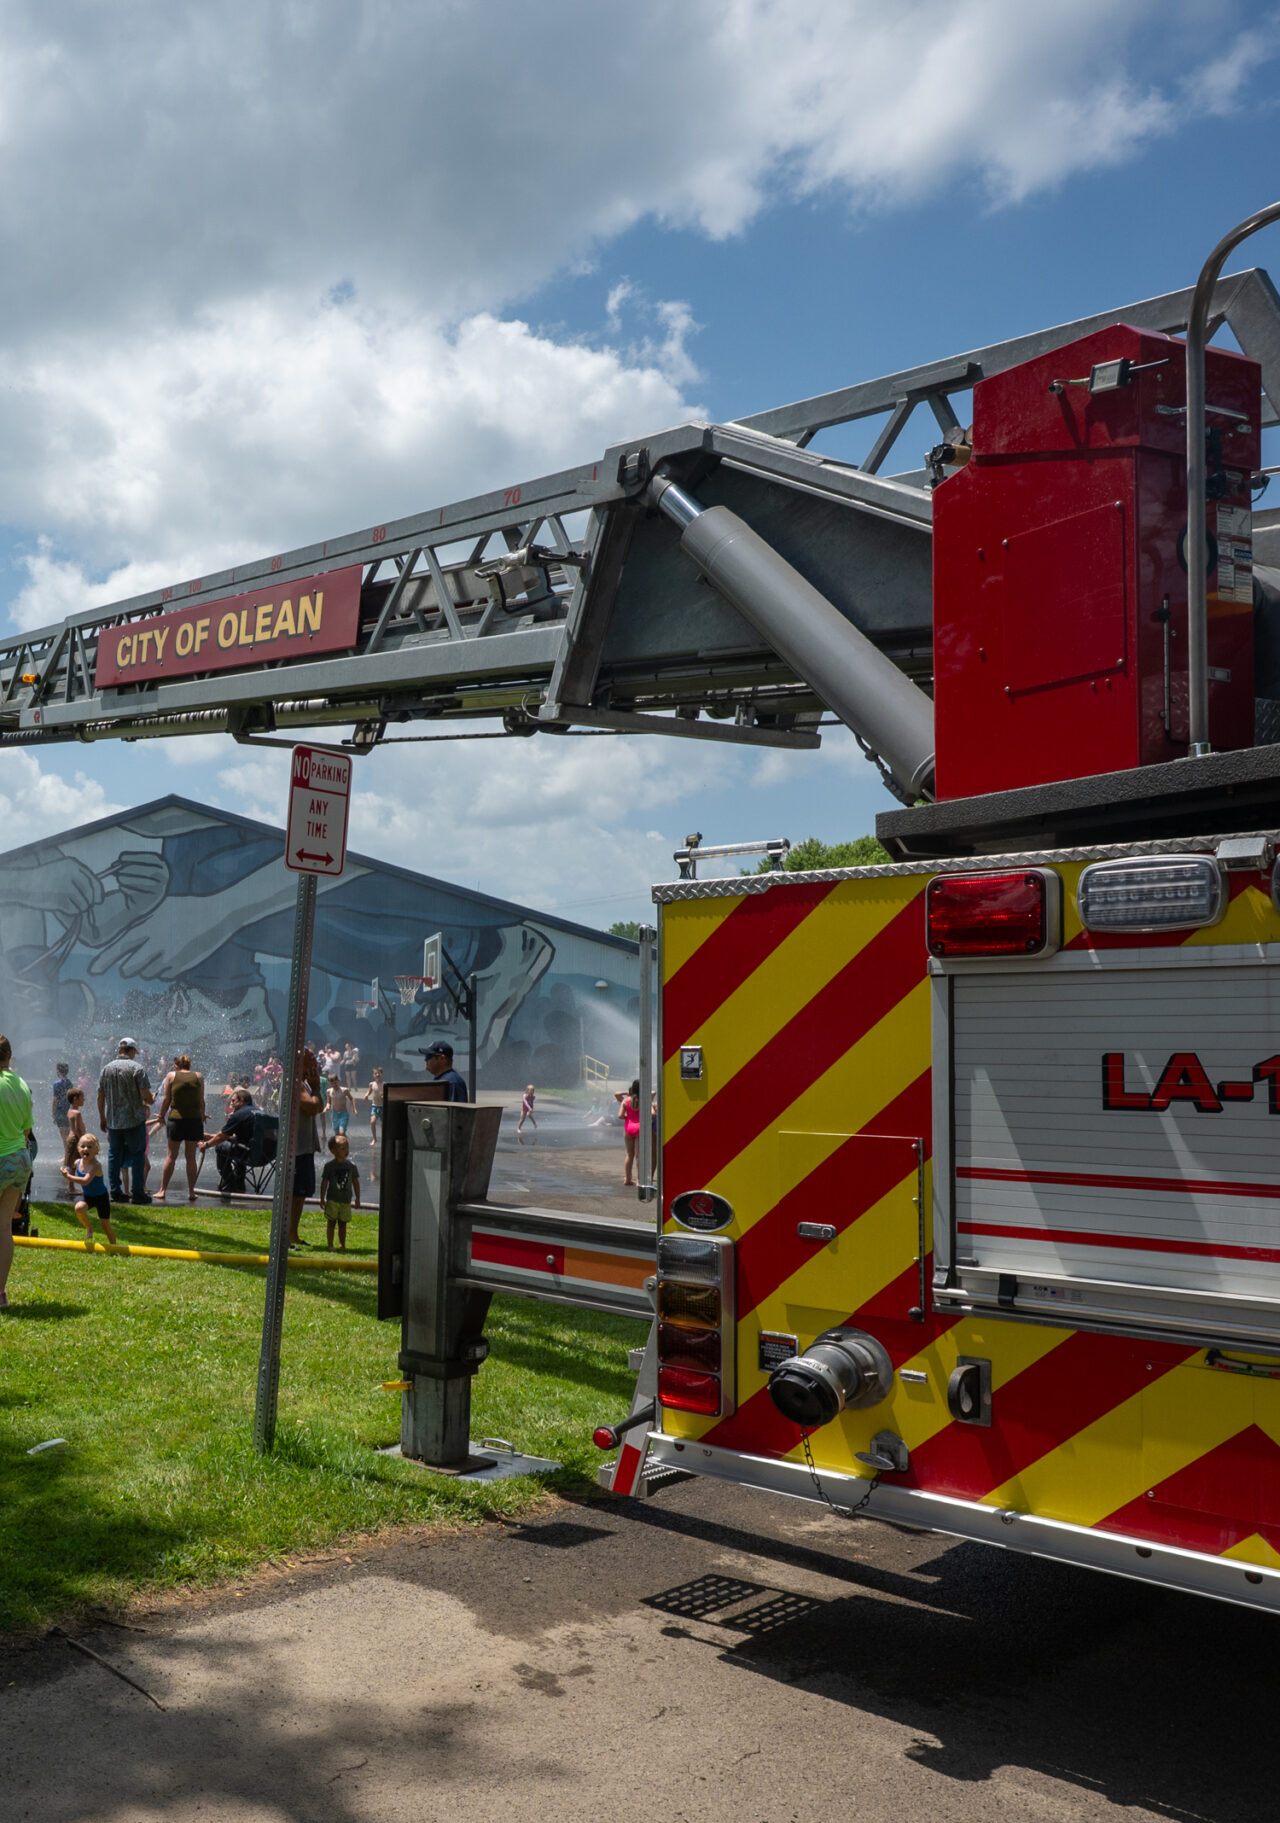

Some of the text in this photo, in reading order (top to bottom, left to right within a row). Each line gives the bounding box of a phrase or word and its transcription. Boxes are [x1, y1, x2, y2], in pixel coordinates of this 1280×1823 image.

[504, 487, 521, 507] 70
[372, 526, 387, 543] 80
[271, 556, 282, 571] 90
[116, 592, 324, 668] CITY OF OLEAN
[293, 755, 347, 784] NO PARKING
[309, 798, 328, 816] ANY
[306, 820, 327, 839] TIME
